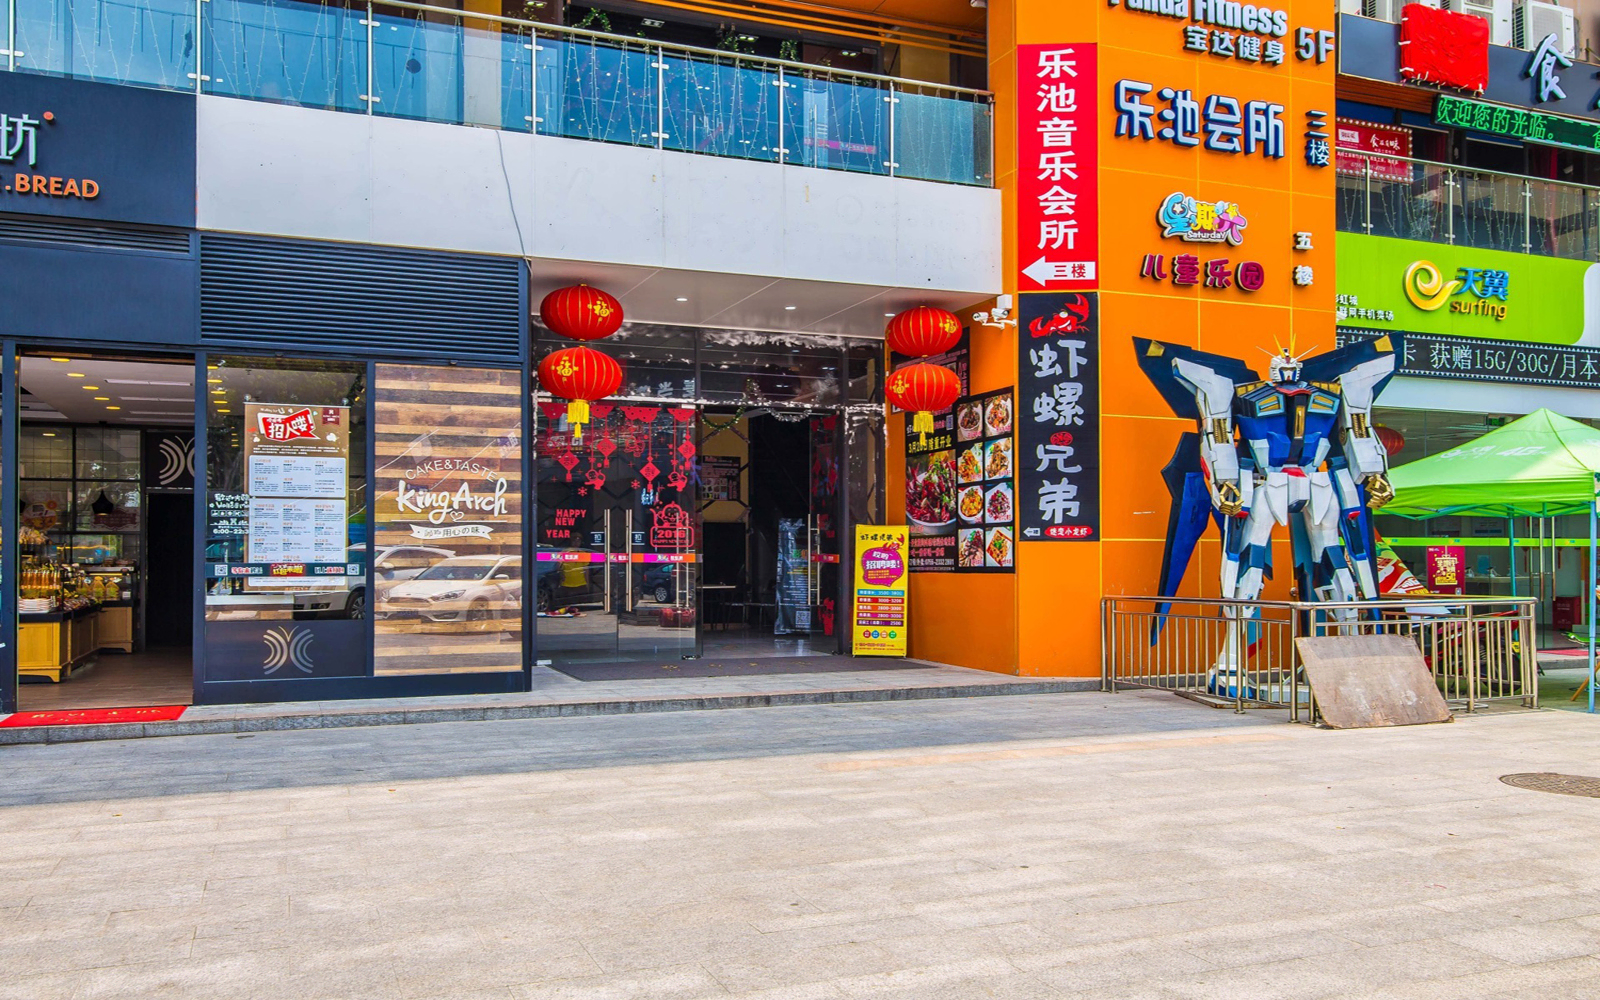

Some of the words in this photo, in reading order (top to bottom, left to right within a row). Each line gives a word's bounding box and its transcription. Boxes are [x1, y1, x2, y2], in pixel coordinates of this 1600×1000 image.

[1186, 26, 1285, 64] 宝达健身
[1297, 27, 1335, 63] 5F
[1527, 32, 1574, 102] 食
[1115, 79, 1285, 158] 乐池会所
[1036, 48, 1079, 250] 乐池音乐会所
[1305, 110, 1330, 166] 三楼
[1053, 264, 1087, 279] 三楼
[1454, 266, 1510, 301] 天翼
[1336, 305, 1395, 322] 联网手机卖场
[1450, 299, 1508, 320] surfing
[1430, 342, 1600, 381] 获赠15G/30G/月本
[1029, 339, 1088, 524] 虾螺兄弟
[405, 459, 498, 482] CAKE&TASTE
[555, 517, 576, 526] NEW
[556, 509, 587, 518] HAPPY
[546, 530, 571, 538] YEAR
[656, 530, 686, 539] 2016
